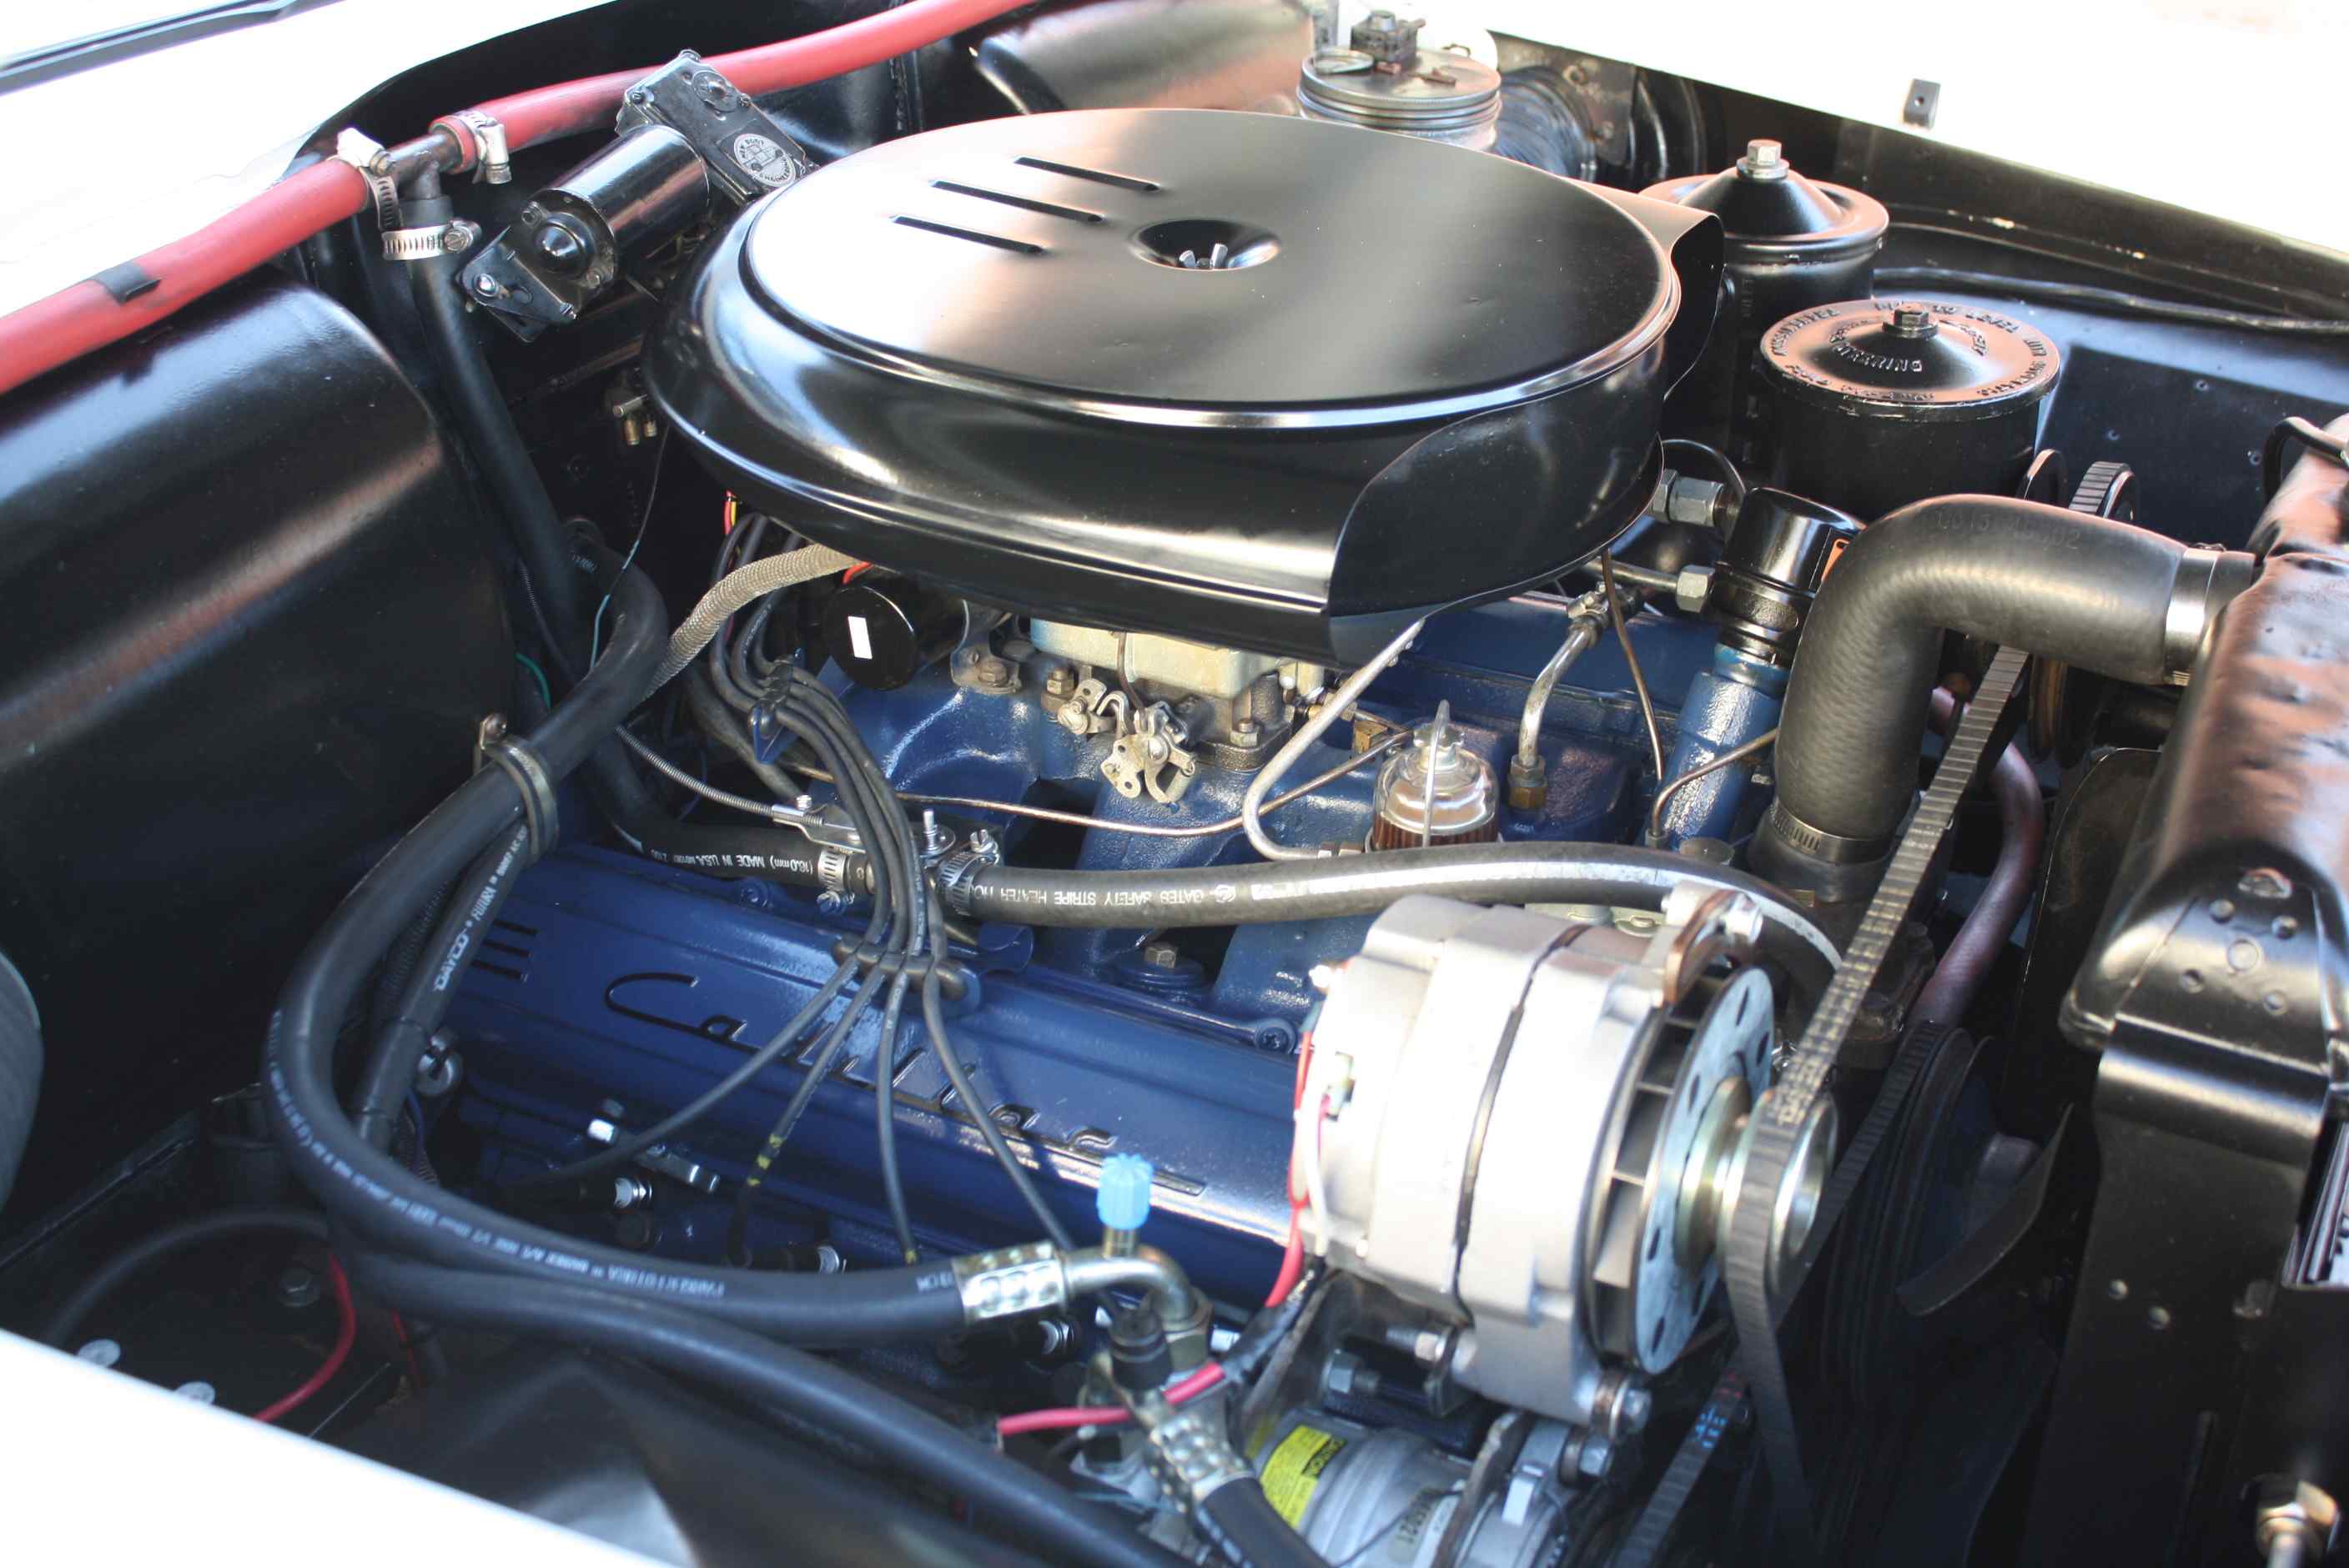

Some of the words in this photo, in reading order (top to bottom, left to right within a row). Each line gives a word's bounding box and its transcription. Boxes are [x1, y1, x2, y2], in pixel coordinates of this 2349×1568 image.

[721, 854, 732, 867] IN
[737, 854, 766, 869] MADE
[999, 887, 1048, 905] HEATER
[1053, 889, 1097, 906] STRIPE
[1103, 890, 1151, 907] SAFETY
[1160, 891, 1205, 905] GATES
[432, 927, 472, 993] DAYCO
